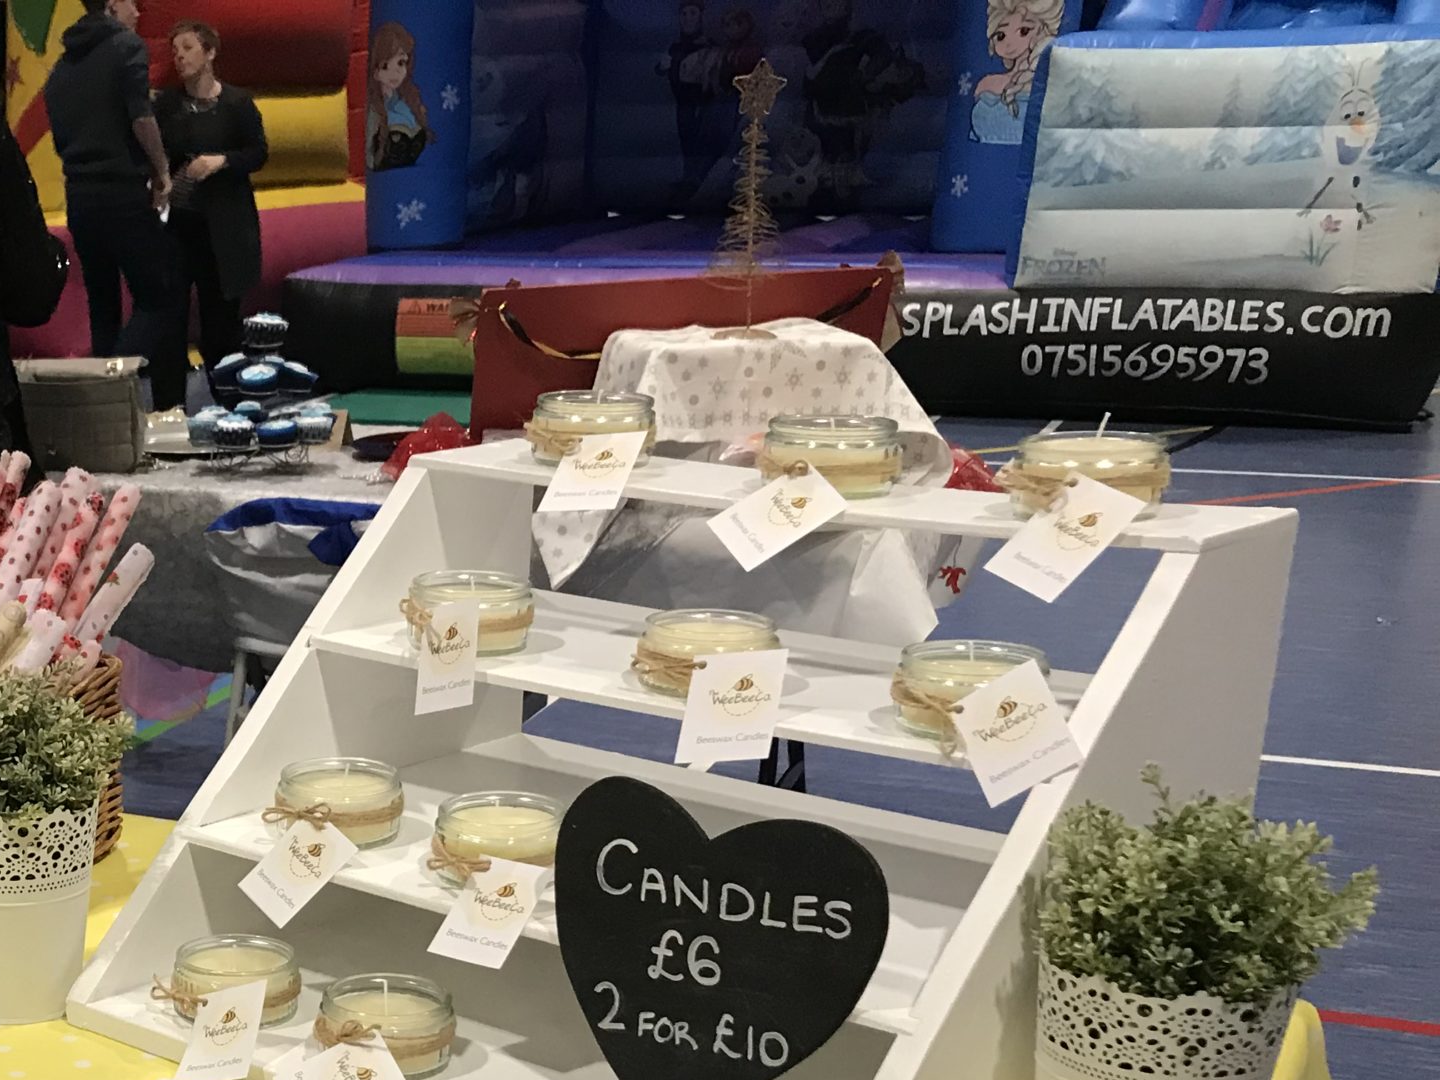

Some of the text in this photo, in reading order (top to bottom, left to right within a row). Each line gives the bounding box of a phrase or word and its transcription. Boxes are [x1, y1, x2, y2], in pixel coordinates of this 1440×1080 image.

[902, 297, 1392, 338] SPLASHINFLATABLES.com
[1021, 341, 1270, 385] 07515695973
[596, 838, 852, 940] CANDLES
[647, 929, 721, 986] £6
[593, 981, 789, 1068] 2 FOR £10
